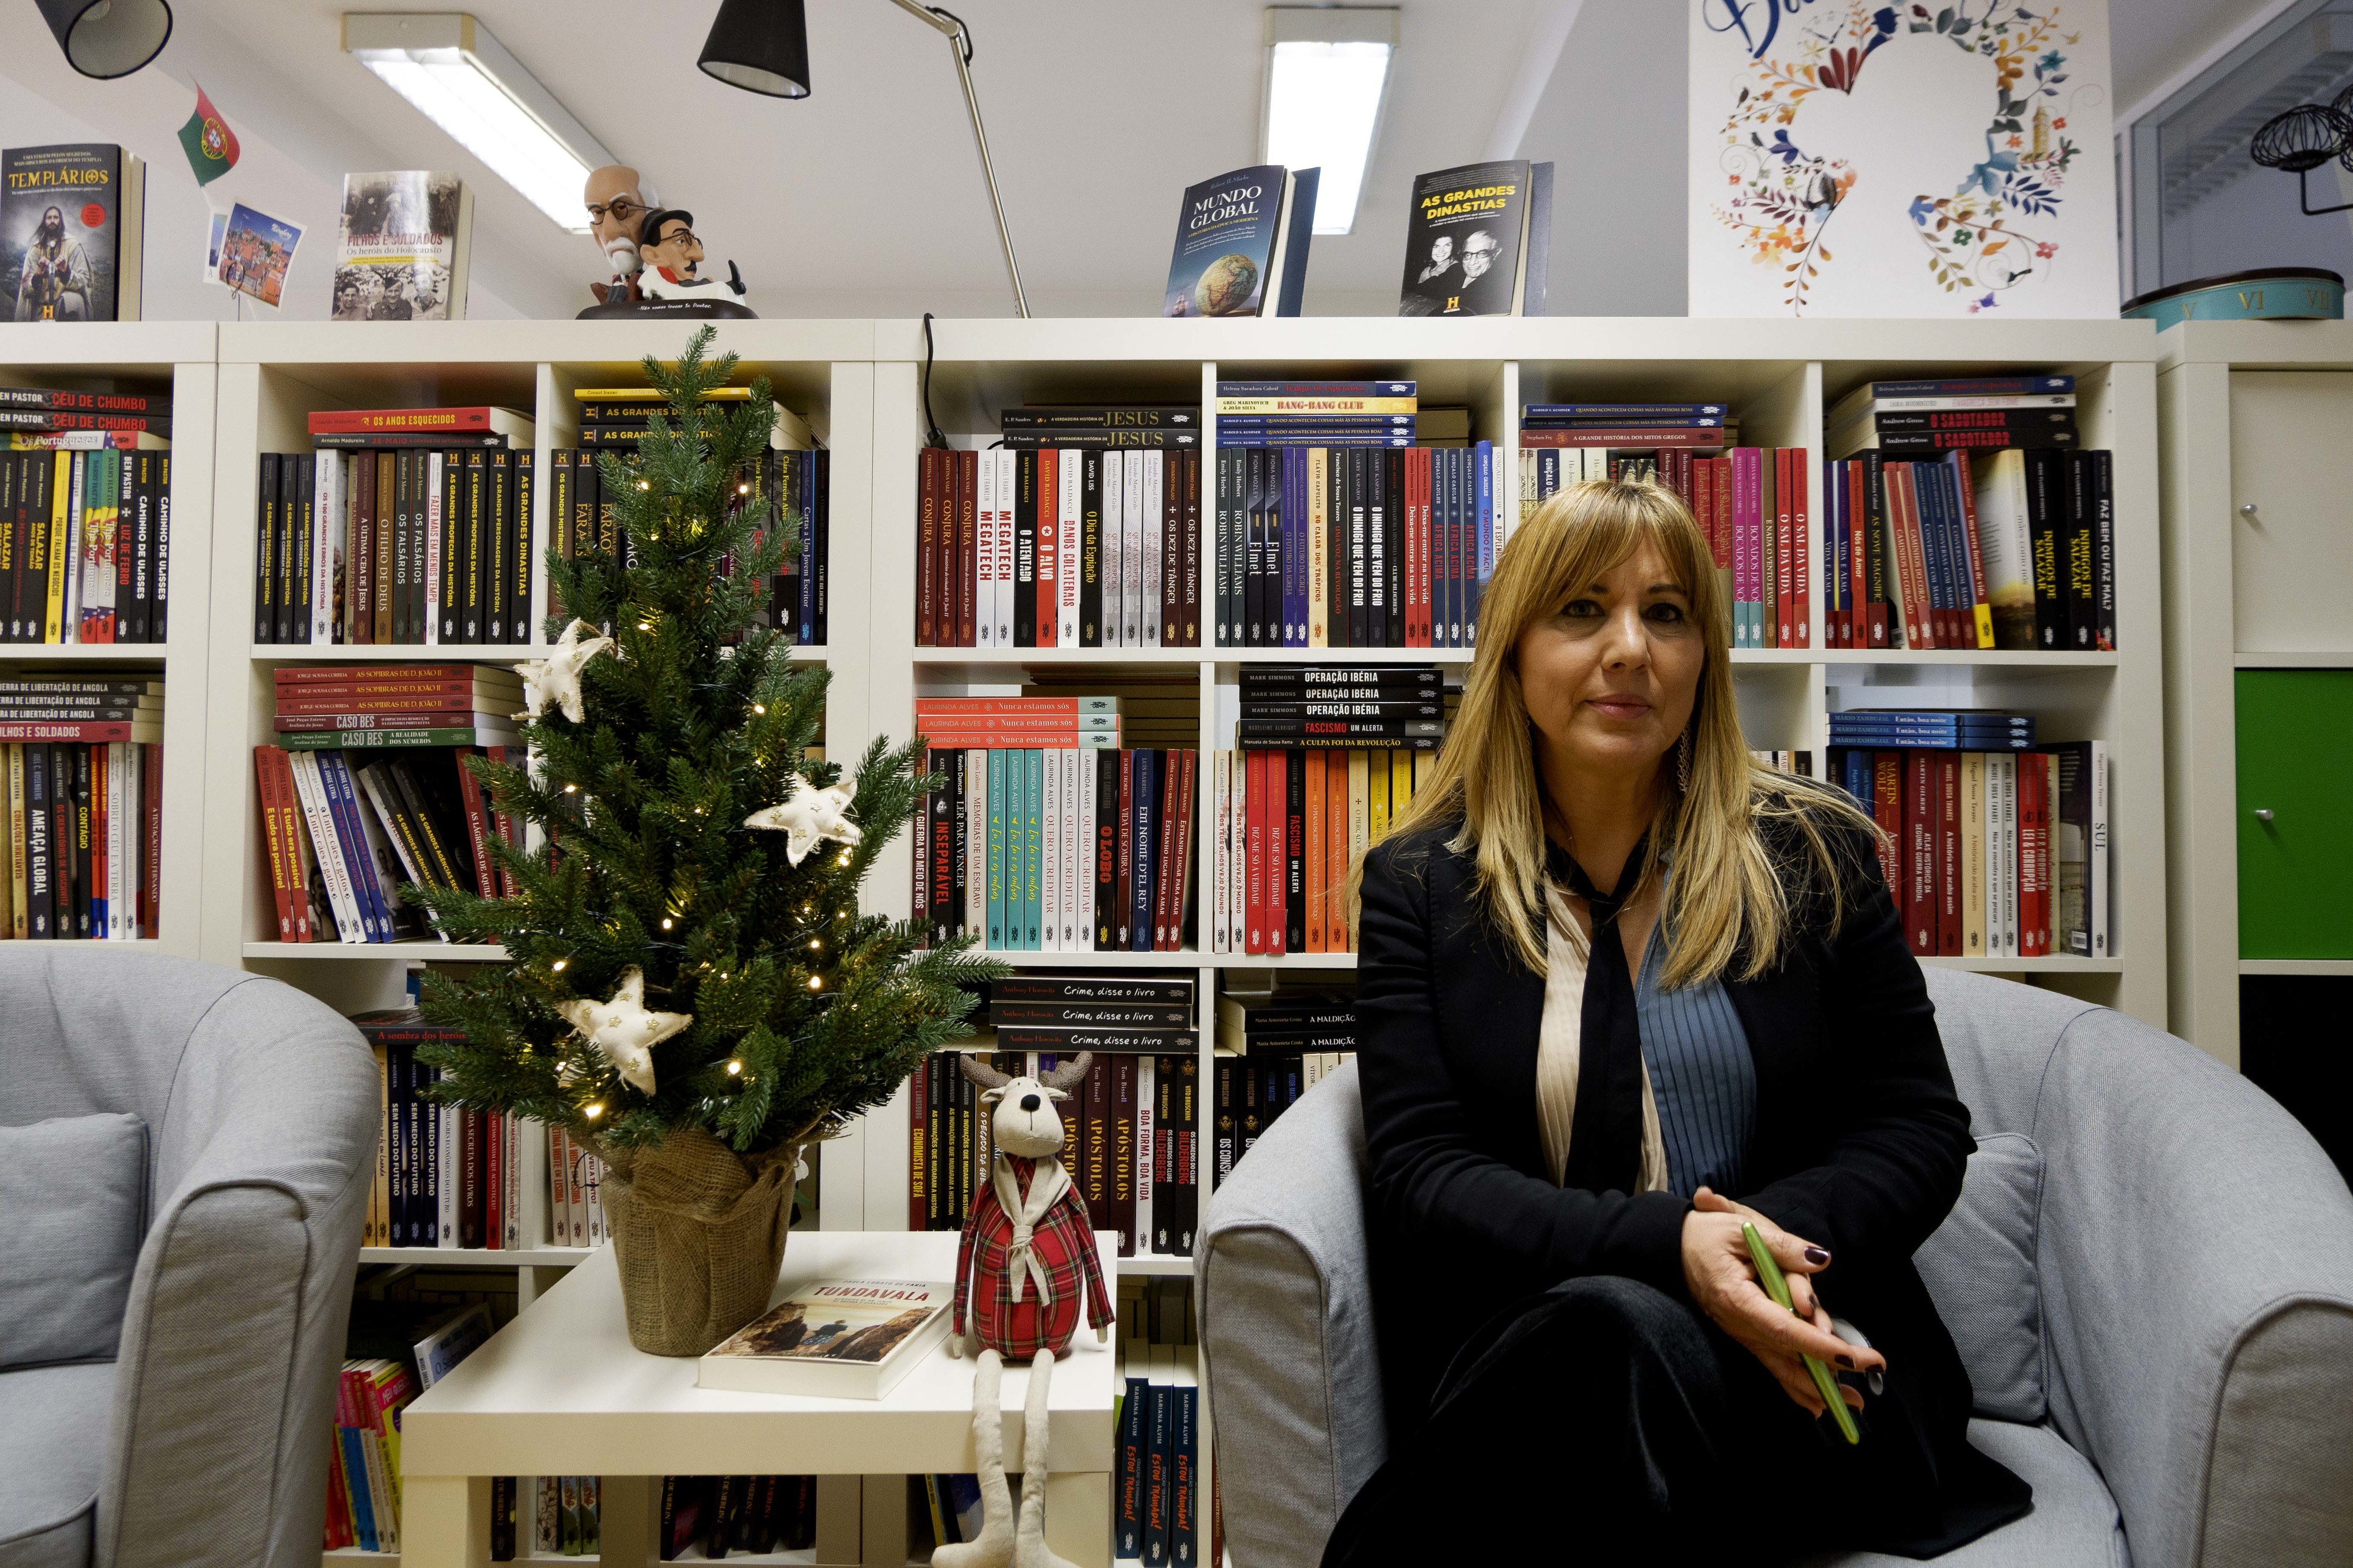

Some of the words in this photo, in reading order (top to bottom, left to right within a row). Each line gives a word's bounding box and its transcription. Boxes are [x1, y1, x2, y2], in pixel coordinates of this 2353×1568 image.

[9, 166, 108, 188] TEMPLÁRIOS
[1194, 186, 1262, 215] MUNDO
[1421, 195, 1440, 208] AS
[1443, 185, 1516, 204] GRANDES
[1191, 201, 1258, 229] GLOBAL
[1427, 198, 1506, 219] DINASTIAS
[346, 247, 356, 255] Os
[359, 246, 382, 255] heróis
[53, 392, 75, 406] CÉU
[79, 394, 94, 408] DE
[98, 397, 146, 410] CHUMBO
[374, 417, 383, 425] OS
[385, 416, 406, 425] ANOS
[409, 415, 455, 425] ESQUECIDOS
[1104, 412, 1158, 426] JESUS
[21, 436, 34, 446] Os
[35, 435, 97, 447] Portugueses
[1107, 432, 1163, 446] JESUS
[123, 473, 132, 499] PASTOR
[521, 475, 528, 488] AS
[520, 492, 528, 539] GRANDES
[1780, 514, 1789, 522] O
[2100, 500, 2109, 518] FAZ
[138, 496, 147, 541] CAMINHO
[381, 519, 389, 527] O
[399, 514, 406, 527] OS
[924, 498, 932, 542] CONJURA
[1087, 520, 1096, 531] Dia
[1188, 519, 1195, 531] OS
[1234, 511, 1242, 541] ROBIN
[121, 525, 131, 540] LUZ
[1064, 521, 1075, 549] DANOS
[1372, 514, 1382, 542] INIMIGO
[1780, 526, 1789, 546] SAL
[2101, 522, 2110, 542] BEM
[380, 532, 388, 563] FILHO
[804, 538, 811, 552] Um
[980, 512, 992, 581] MEGATECH
[1086, 535, 1096, 545] da
[119, 543, 130, 556] DE
[138, 543, 145, 557] DE
[398, 531, 408, 585] FALSÁRIOS
[1188, 553, 1194, 564] DE
[1372, 544, 1382, 559] QUE
[1781, 550, 1789, 564] DA
[2101, 545, 2110, 559] OU
[802, 553, 811, 576] Jovem
[1019, 539, 1032, 582] ATENTADO
[1039, 555, 1054, 581] ALVO
[1085, 547, 1096, 583] Expiação
[1267, 542, 1279, 576] Elmet
[119, 558, 130, 585] FERRO
[380, 567, 388, 581] DE
[519, 542, 527, 596] DINASTIAS
[1372, 561, 1382, 576] VEM
[2101, 563, 2111, 581] FAZ
[136, 559, 145, 599] ULISSES
[1063, 552, 1074, 607] COLATERAIS
[1187, 568, 1196, 604] TÂNGER
[1372, 578, 1382, 588] DO
[1781, 567, 1789, 594] VIDA
[379, 585, 388, 612] DEUS
[1372, 589, 1382, 606] FRIO
[2102, 585, 2112, 610] MAL?
[1305, 672, 1348, 683] OPERAÇÃO
[1351, 671, 1378, 682] IBÉRIA
[1306, 688, 1348, 700] OPERAÇÃO
[1351, 688, 1379, 699] IBÉRIA
[1307, 704, 1349, 716] OPERAÇÃO
[1352, 704, 1379, 715] IBÉRIA
[336, 716, 357, 728] CASO
[359, 715, 374, 728] BES
[1306, 723, 1347, 733] FASCISMO
[342, 733, 364, 746] CASO
[366, 732, 383, 745] BES
[1357, 739, 1401, 748] REVOLUÇÃO
[30, 810, 45, 853] AMEAÇA
[80, 807, 90, 849] CONTÁGIO
[1101, 826, 1112, 836] O
[1291, 815, 1300, 856] FASCISMO
[2095, 823, 2105, 851] SUL
[936, 822, 952, 905] INSEPARÁVEL
[1100, 839, 1112, 883] LOBO
[1292, 860, 1298, 869] UM
[34, 856, 47, 895] GLOBAL
[1065, 986, 1094, 996] Crime,
[1317, 1015, 1355, 1023] MALDIÇÃO
[1141, 1110, 1149, 1125] BOA
[914, 1129, 924, 1169] ECONOMISTA
[1139, 1129, 1149, 1159] FORMA,
[393, 1149, 399, 1160] DO
[1090, 1117, 1105, 1200] APÓSTOLOS
[1179, 1131, 1189, 1184] BILDERBERG
[1140, 1163, 1149, 1178] BOA
[914, 1182, 925, 1197] SOFÁ
[1139, 1182, 1149, 1200] VIDA
[814, 1287, 930, 1301] TUNDAVALA
[1152, 1454, 1161, 1480] ESTOU
[1151, 1484, 1162, 1529] TRAMADA!
